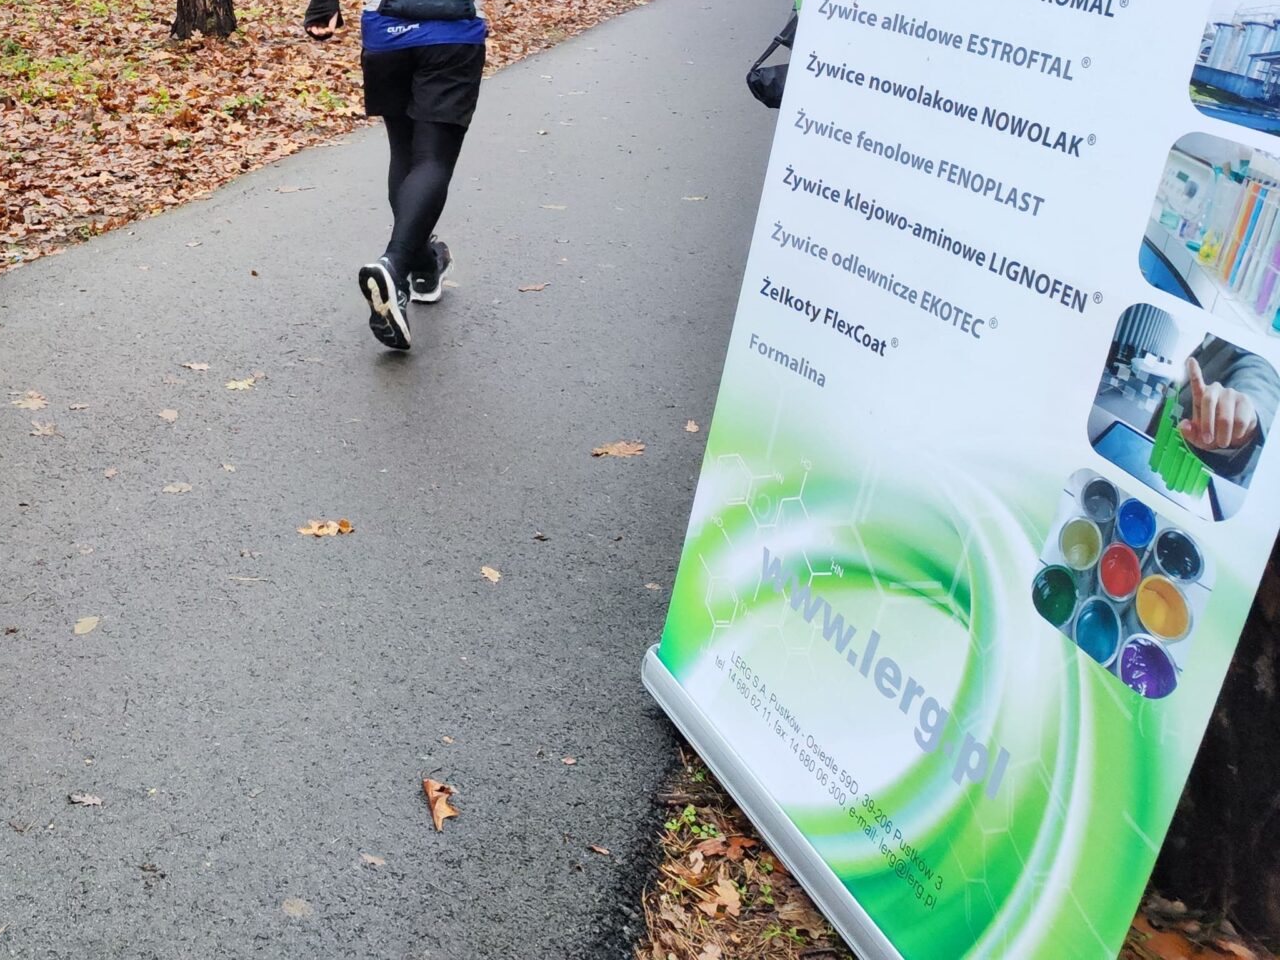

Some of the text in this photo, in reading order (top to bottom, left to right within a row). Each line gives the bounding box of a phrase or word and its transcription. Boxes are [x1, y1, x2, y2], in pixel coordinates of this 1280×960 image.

[880, 13, 963, 49] alkidowe
[806, 51, 865, 86] Żywice
[868, 75, 978, 122] nowolakowe
[793, 108, 1045, 217] Żywice fenolowe FENOPLAST
[770, 220, 829, 262] Żywice
[831, 245, 918, 305] odlewnicze
[781, 164, 841, 204] Żywice
[843, 189, 986, 267] klejowo-aminowe
[759, 276, 822, 324] Żelkoty
[748, 333, 827, 388] Formalina
[762, 546, 1010, 800] www.lerg.pl
[728, 668, 737, 683] 14
[736, 678, 751, 700] 680
[750, 694, 761, 712] 62
[790, 738, 799, 753] 14
[799, 749, 816, 772] 680
[816, 767, 829, 786] 06
[828, 781, 847, 811] 300,
[848, 806, 878, 844] e-mail:
[878, 839, 938, 910] lerg@lerg.pl
[731, 650, 752, 681] LERG
[769, 692, 801, 734] Pustków
[806, 734, 839, 775] Osiedle
[862, 793, 893, 835] 39-206
[893, 828, 934, 880] Pustków
[935, 875, 944, 890] 3
